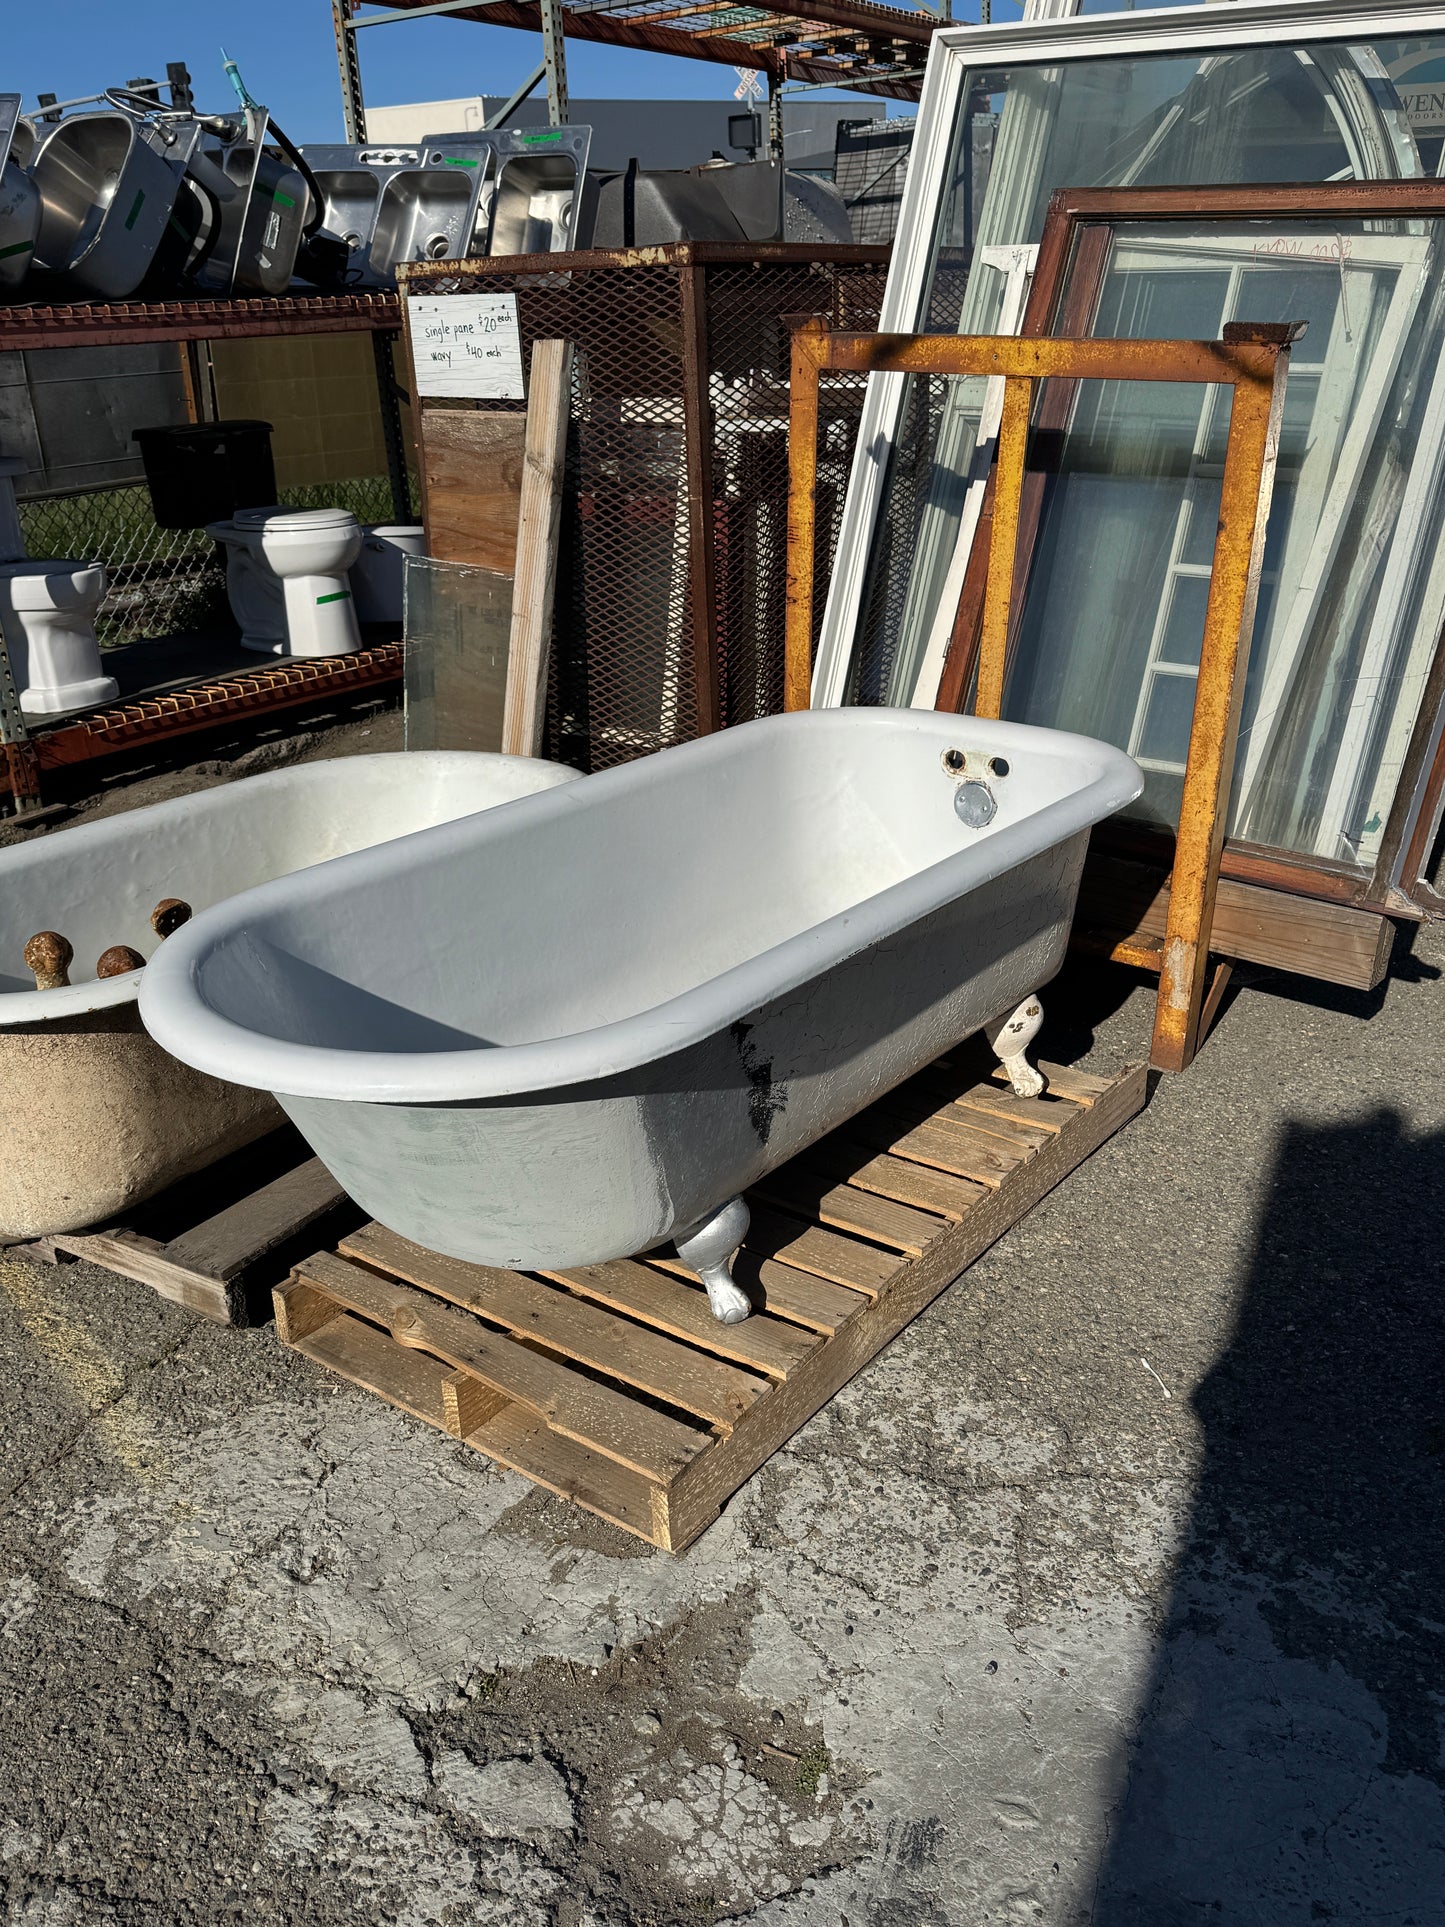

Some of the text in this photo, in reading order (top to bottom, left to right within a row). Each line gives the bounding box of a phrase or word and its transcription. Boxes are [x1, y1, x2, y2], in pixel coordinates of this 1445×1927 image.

[425, 311, 512, 343] single pane $20 each
[431, 342, 502, 368] wavy $40 each
